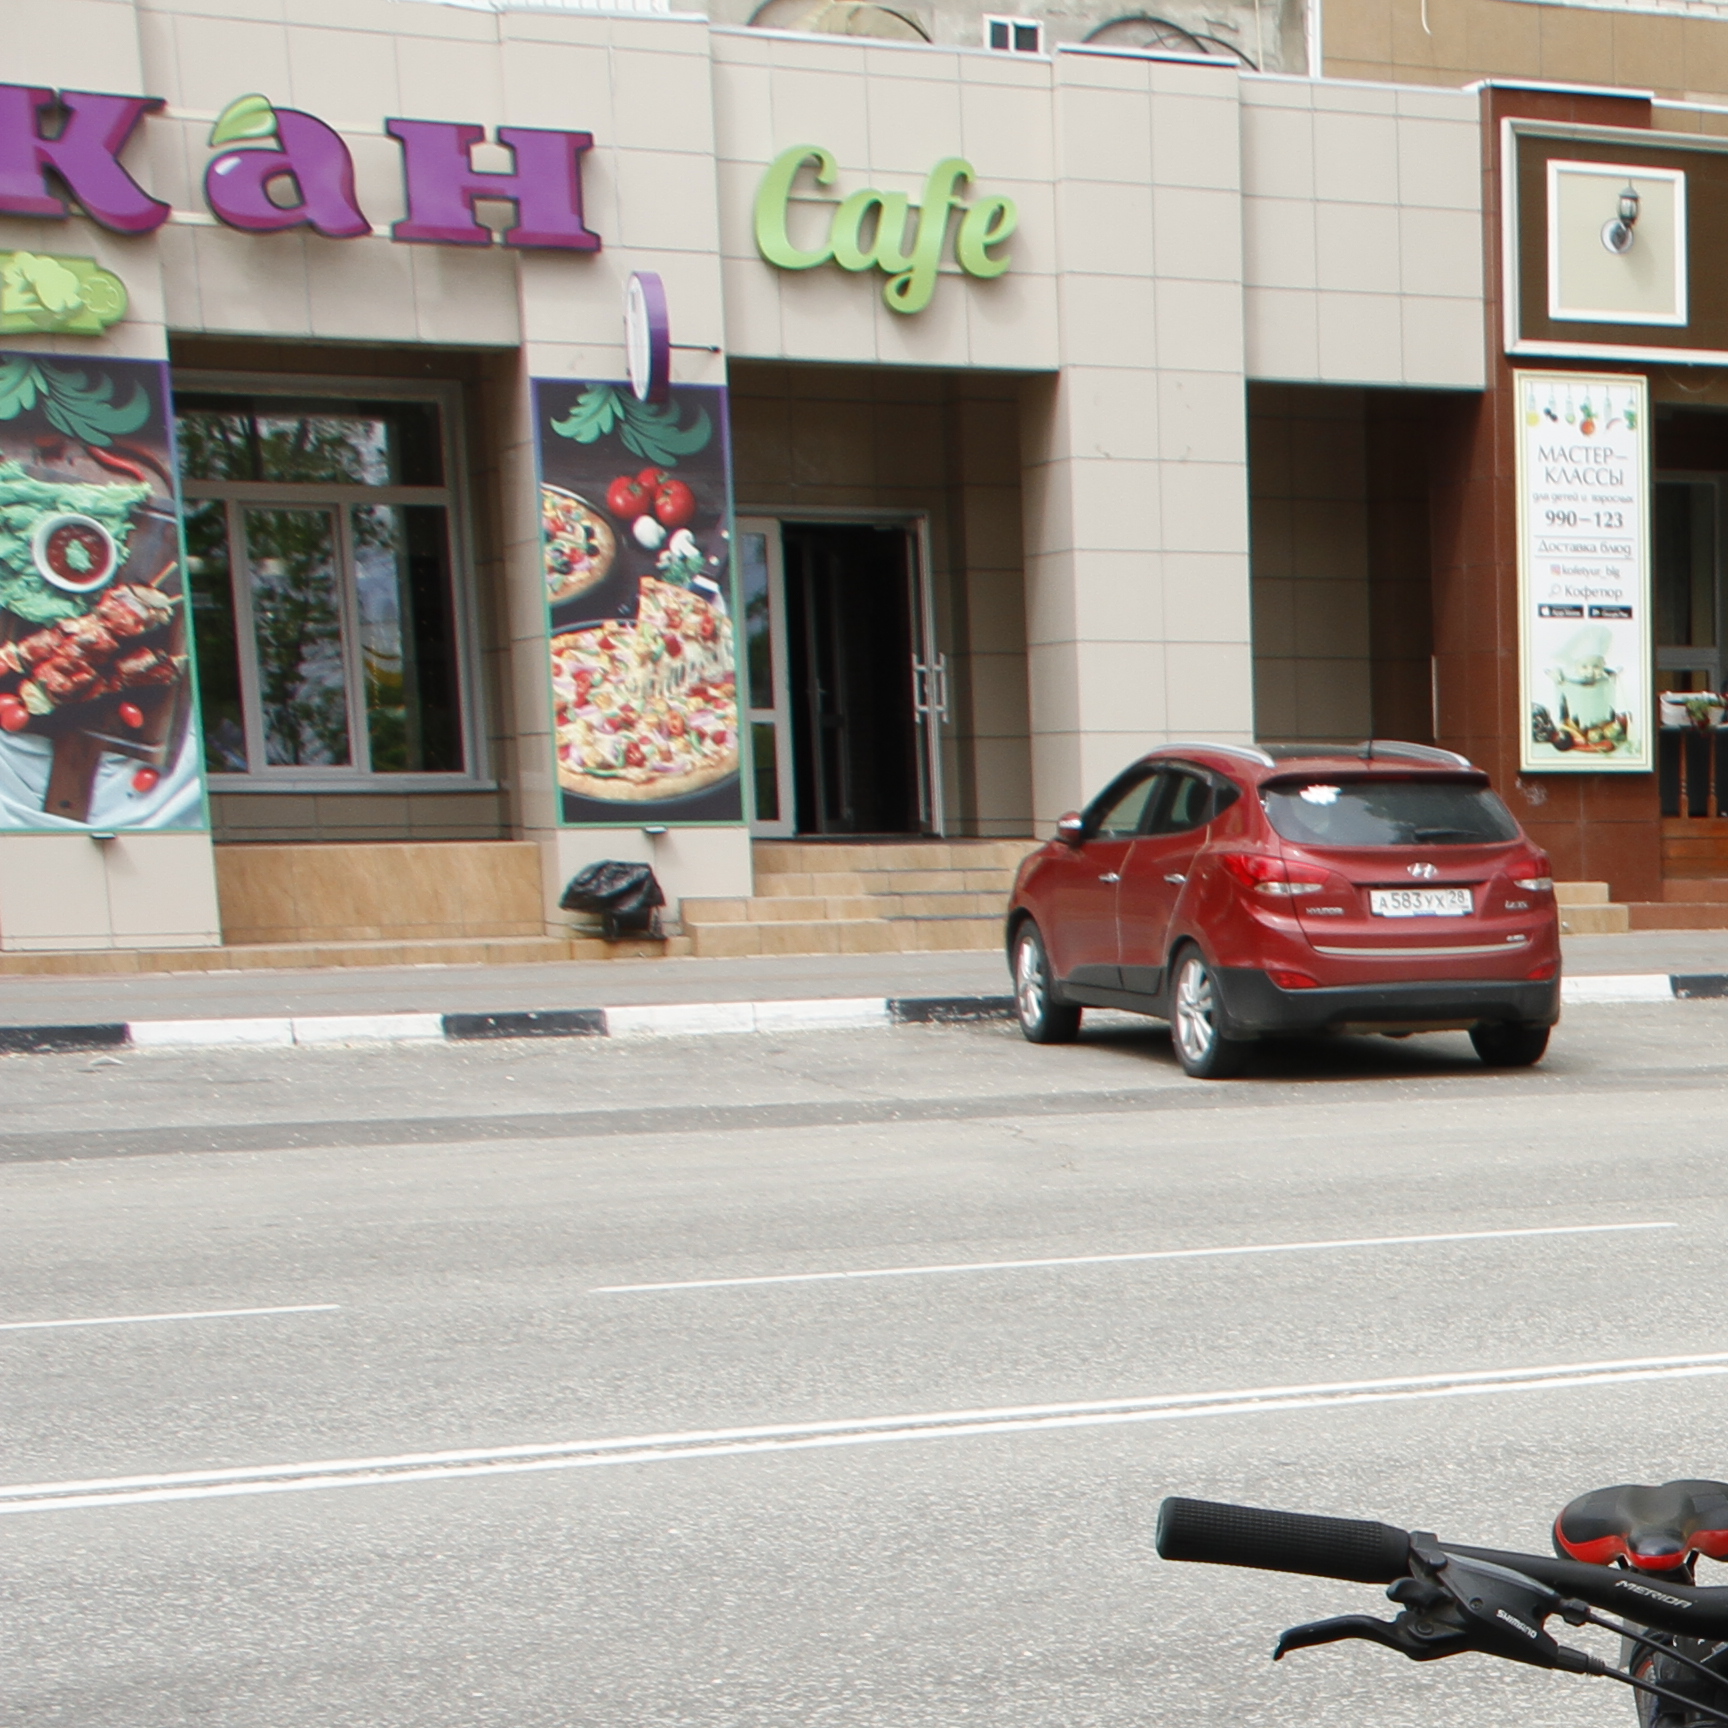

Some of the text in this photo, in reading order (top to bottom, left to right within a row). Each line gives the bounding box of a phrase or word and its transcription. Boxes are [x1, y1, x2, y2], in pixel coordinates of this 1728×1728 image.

[755, 144, 1019, 315] Cafe
[1545, 467, 1624, 486] КЛАССЫ
[1545, 510, 1624, 528] 990-123
[1537, 540, 1632, 556] Доставка блюд
[1565, 585, 1623, 602] Кофетюр
[1448, 890, 1465, 904] 28
[1615, 1579, 1693, 1609] MERIDA
[1496, 1609, 1538, 1639] SHIMANO
